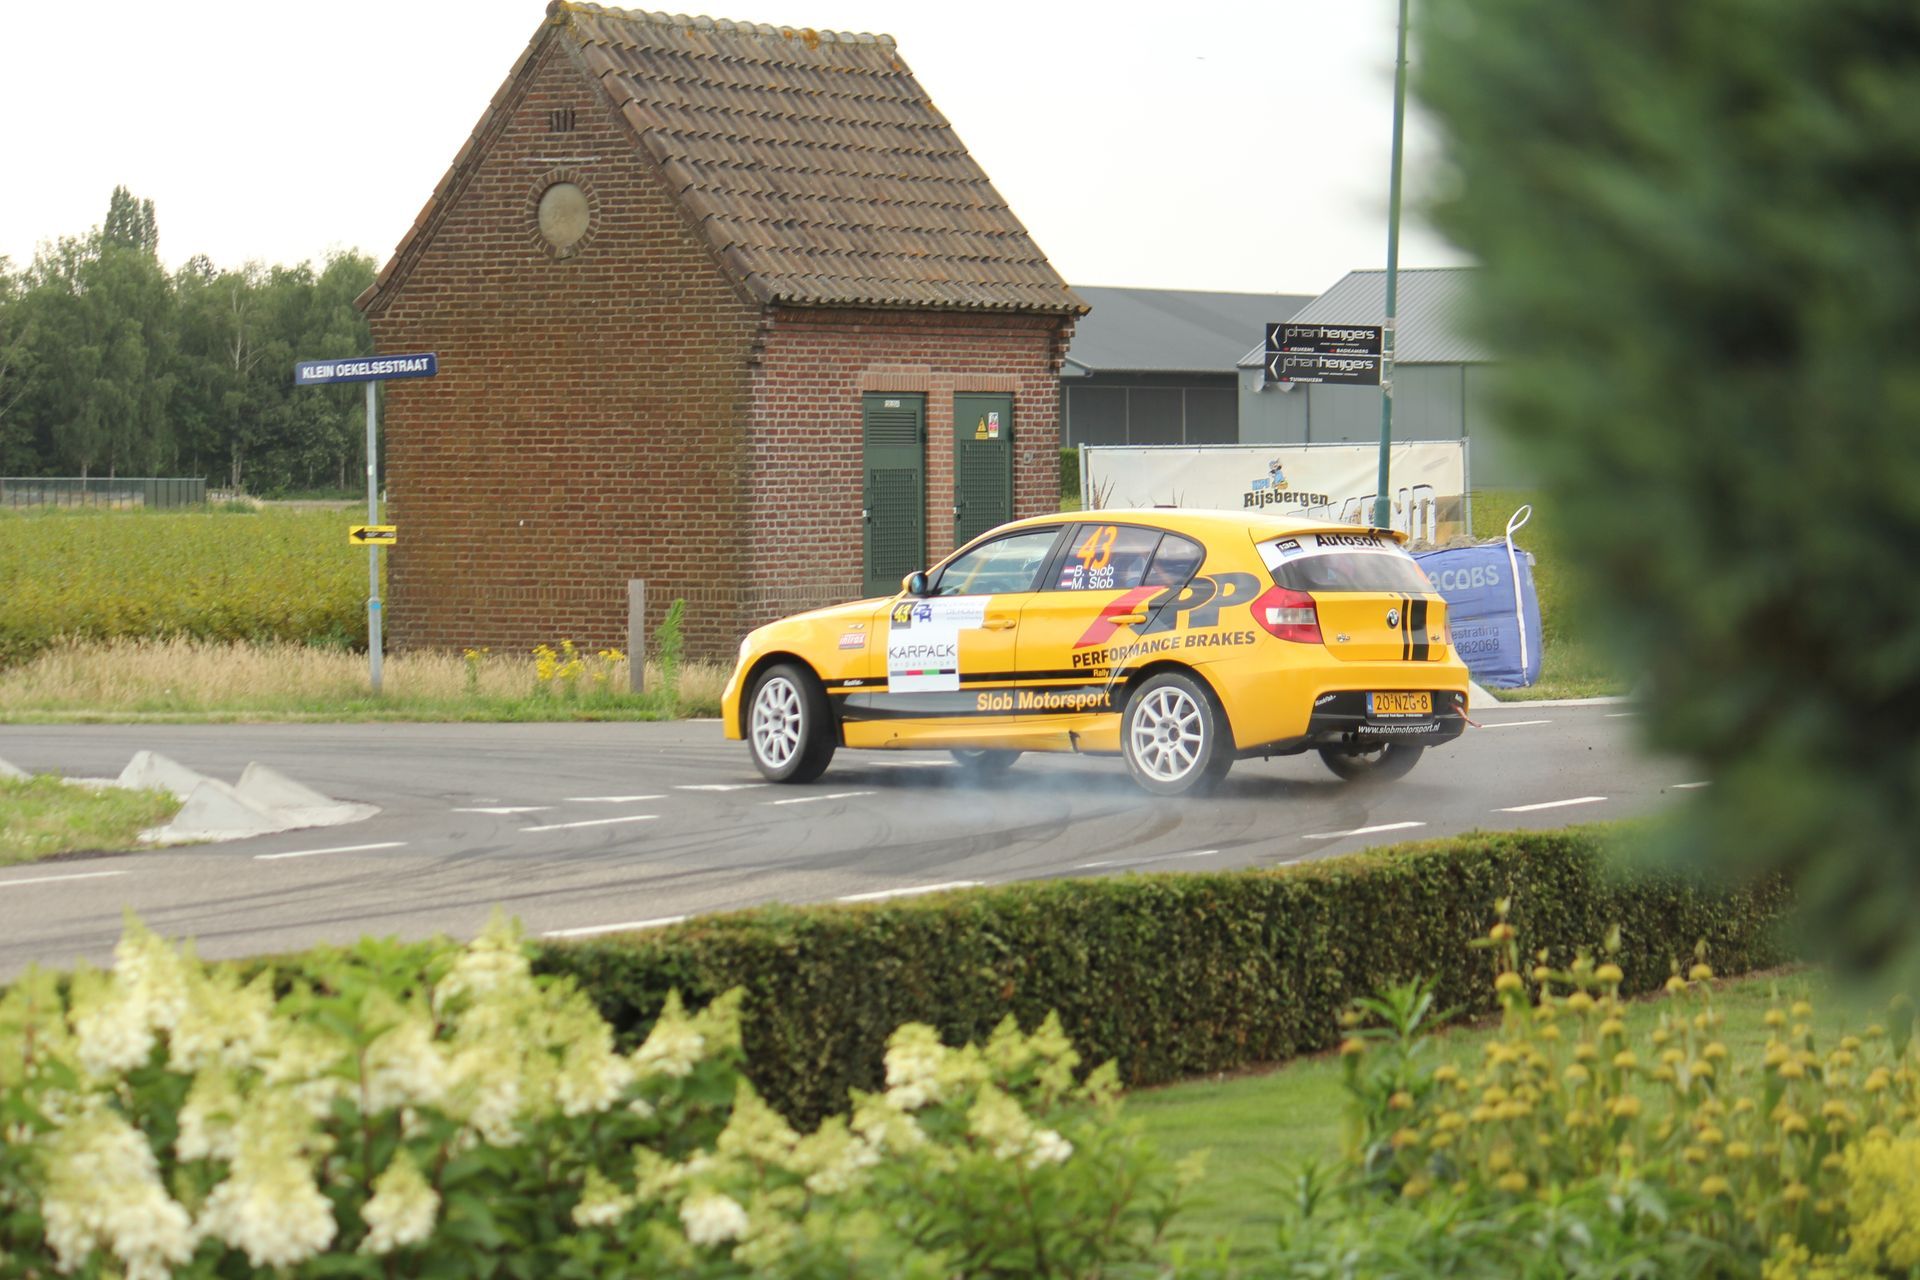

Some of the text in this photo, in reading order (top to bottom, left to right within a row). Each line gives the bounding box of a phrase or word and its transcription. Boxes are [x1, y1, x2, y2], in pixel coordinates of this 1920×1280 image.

[302, 358, 429, 379] KLEIN OEKELSESTRAAT
[1243, 488, 1328, 508] Rijsbergen
[1076, 525, 1118, 570] 43
[1315, 534, 1385, 549] Autosoft
[1074, 563, 1114, 577] B. Slob
[1071, 576, 1114, 590] M. Slob
[894, 600, 913, 623] 43
[889, 644, 956, 660] KARPACK
[1072, 631, 1256, 668] PERFORMANCE BRAKES
[976, 690, 1111, 711] Slob Motorsport
[1358, 721, 1441, 735] www.slobmotorsport.nl
